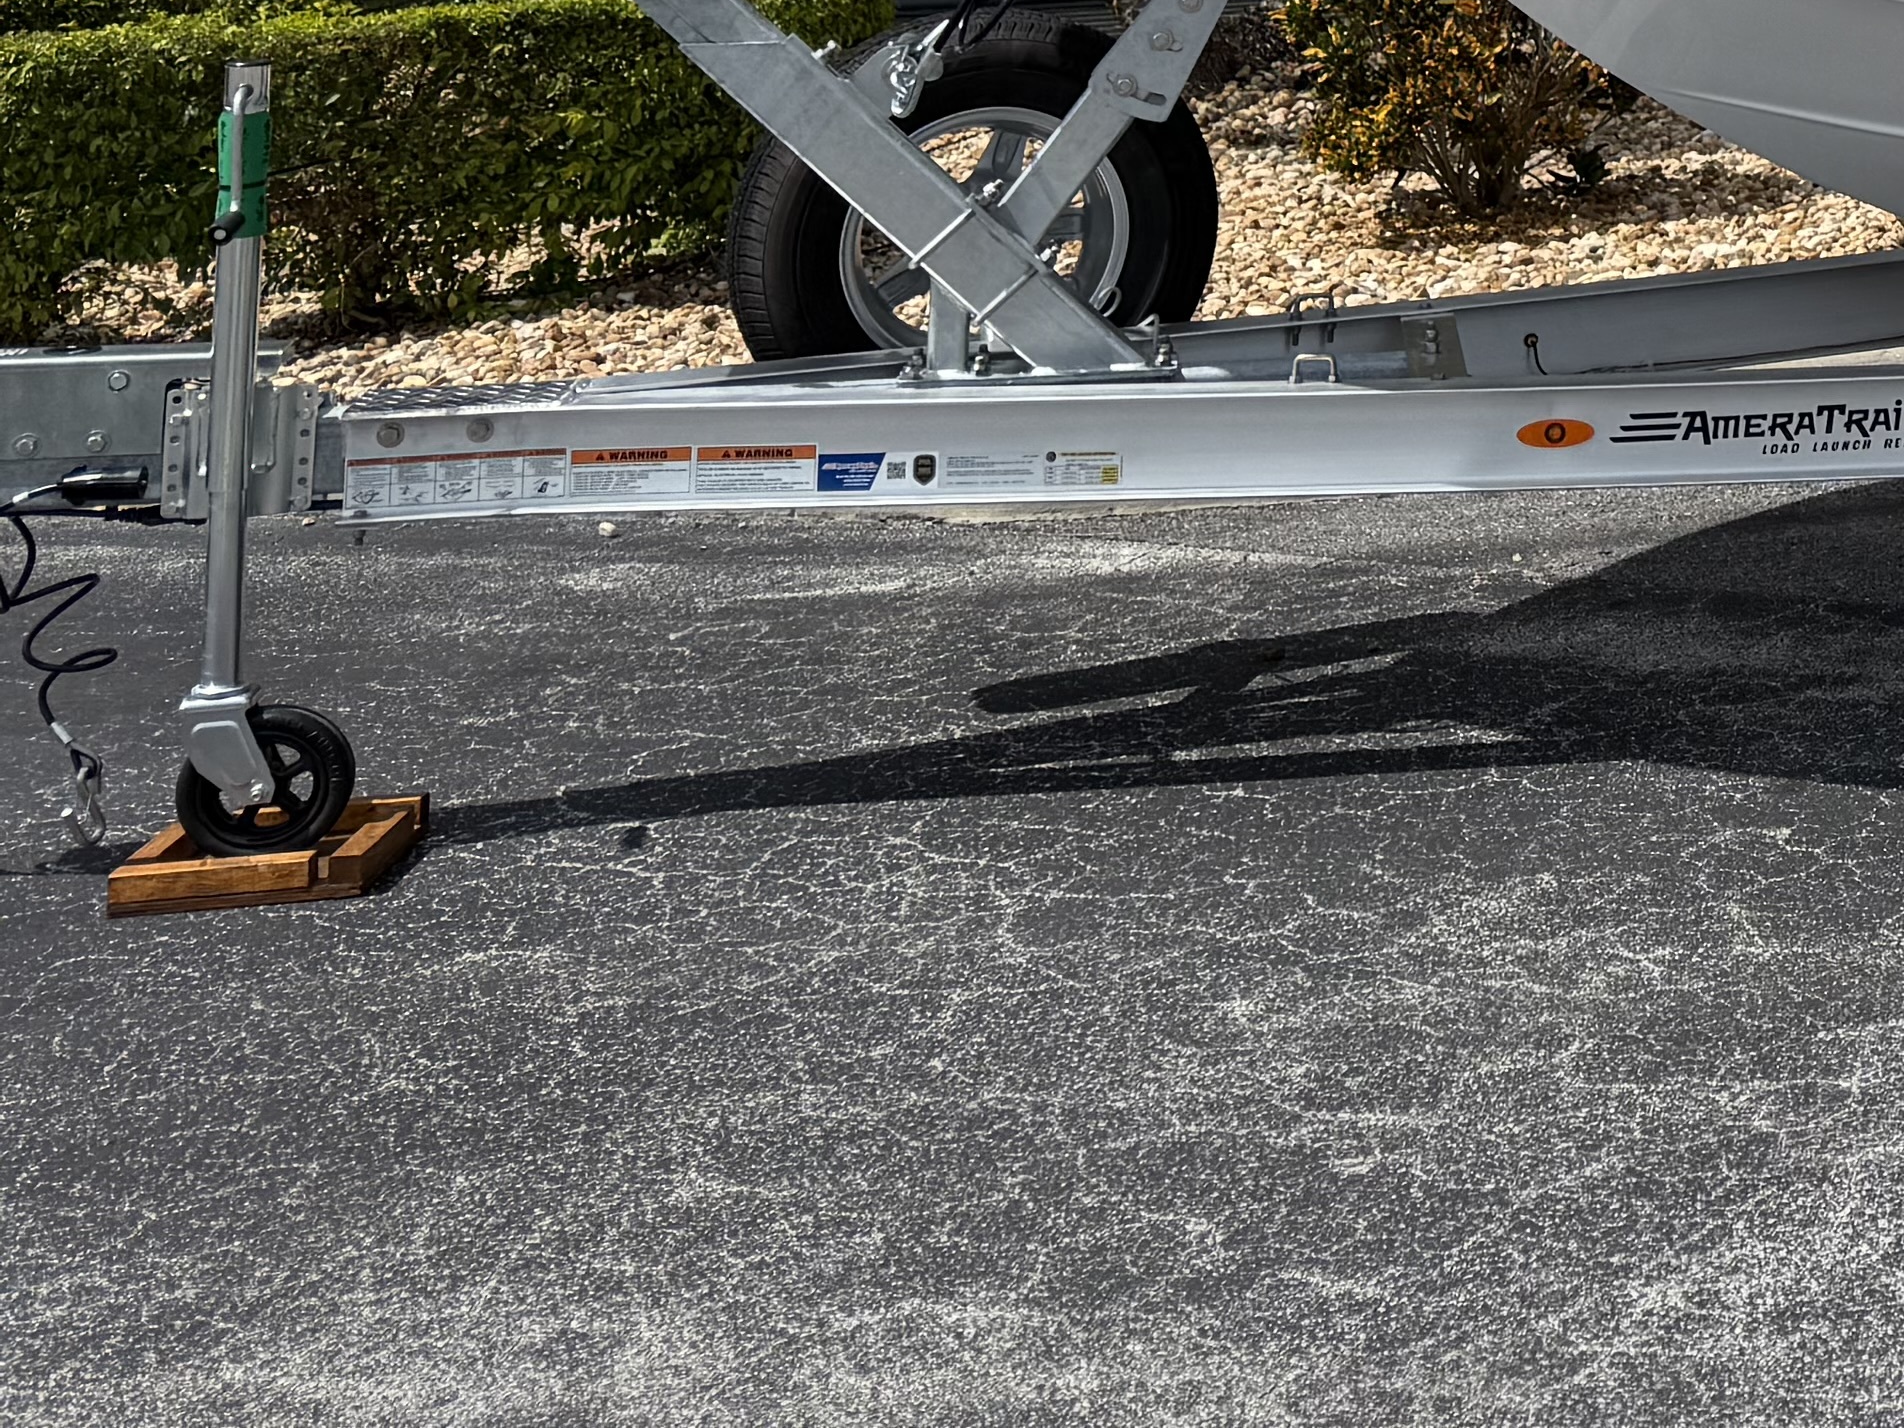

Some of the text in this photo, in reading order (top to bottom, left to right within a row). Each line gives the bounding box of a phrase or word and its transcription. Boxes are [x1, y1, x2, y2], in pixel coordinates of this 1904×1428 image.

[734, 448, 794, 459] WARNING
[1761, 443, 1801, 456] LOAD
[1812, 439, 1873, 453] LAUNCH
[608, 449, 669, 462] WARNING
